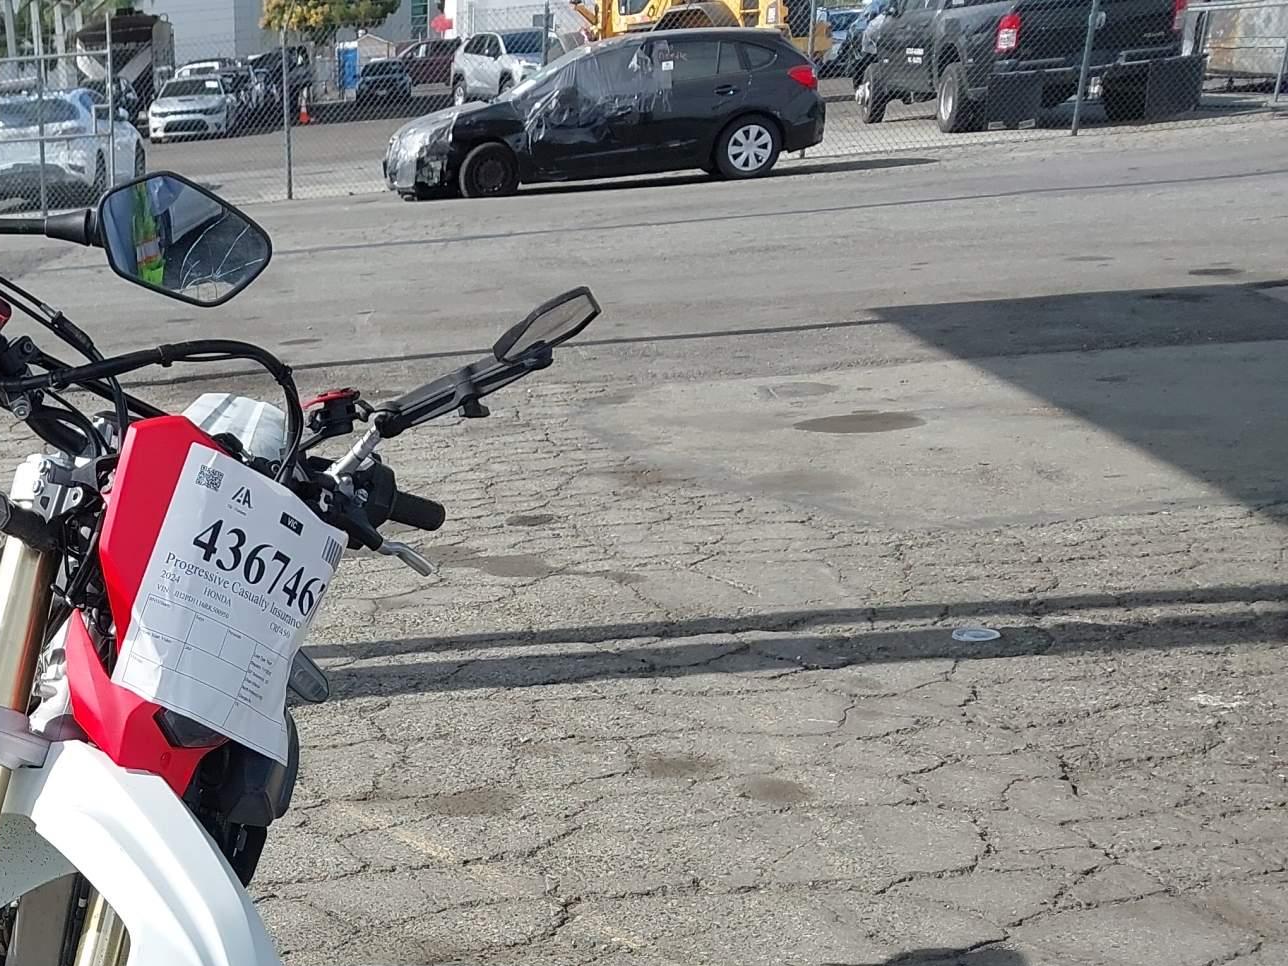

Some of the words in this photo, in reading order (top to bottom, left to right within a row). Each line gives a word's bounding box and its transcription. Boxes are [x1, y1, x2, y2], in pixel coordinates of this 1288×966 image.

[287, 516, 298, 530] VIC
[160, 569, 181, 584] 2024
[204, 586, 232, 607] HONDA
[165, 552, 229, 589] Progressive
[231, 581, 269, 612] Casualty
[192, 519, 326, 617] 436746
